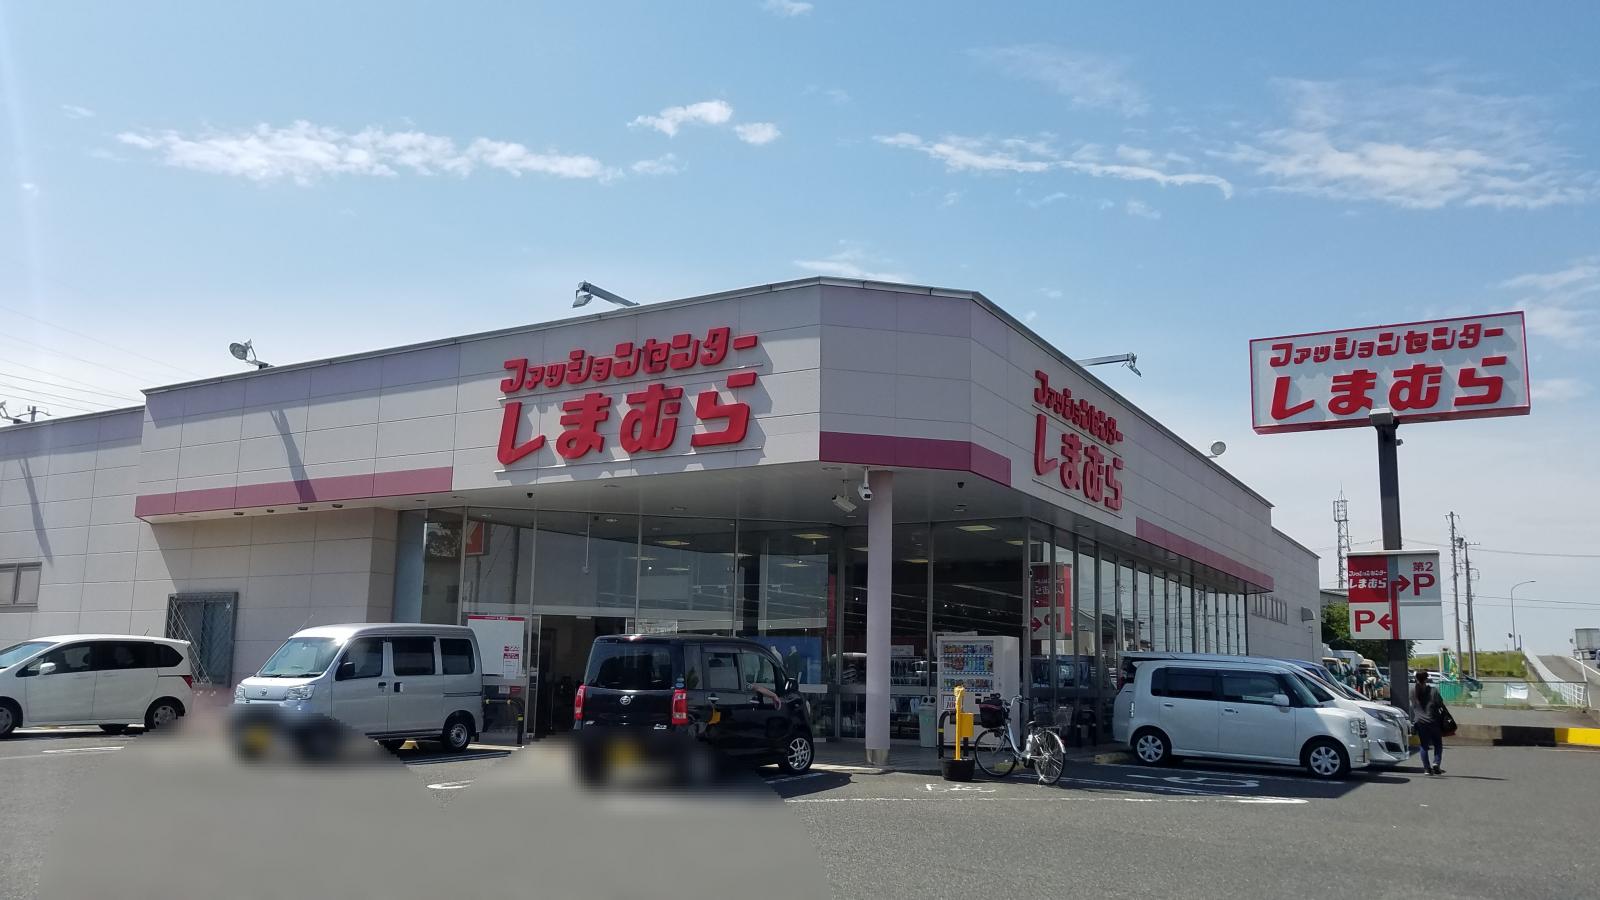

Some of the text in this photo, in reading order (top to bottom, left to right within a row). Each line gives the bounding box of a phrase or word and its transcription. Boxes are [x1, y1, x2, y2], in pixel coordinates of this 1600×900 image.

[500, 327, 758, 393] ファッションセンター
[1270, 323, 1504, 367] ファッションセンター
[1034, 370, 1123, 445] ファッションセンター
[1270, 356, 1507, 420] しまむら
[497, 372, 758, 465] しまむら
[1034, 414, 1124, 511] しまむら
[1349, 577, 1387, 589] しまむら
[1412, 561, 1433, 572] 第2
[1412, 573, 1435, 596] P
[1354, 610, 1376, 633] P
